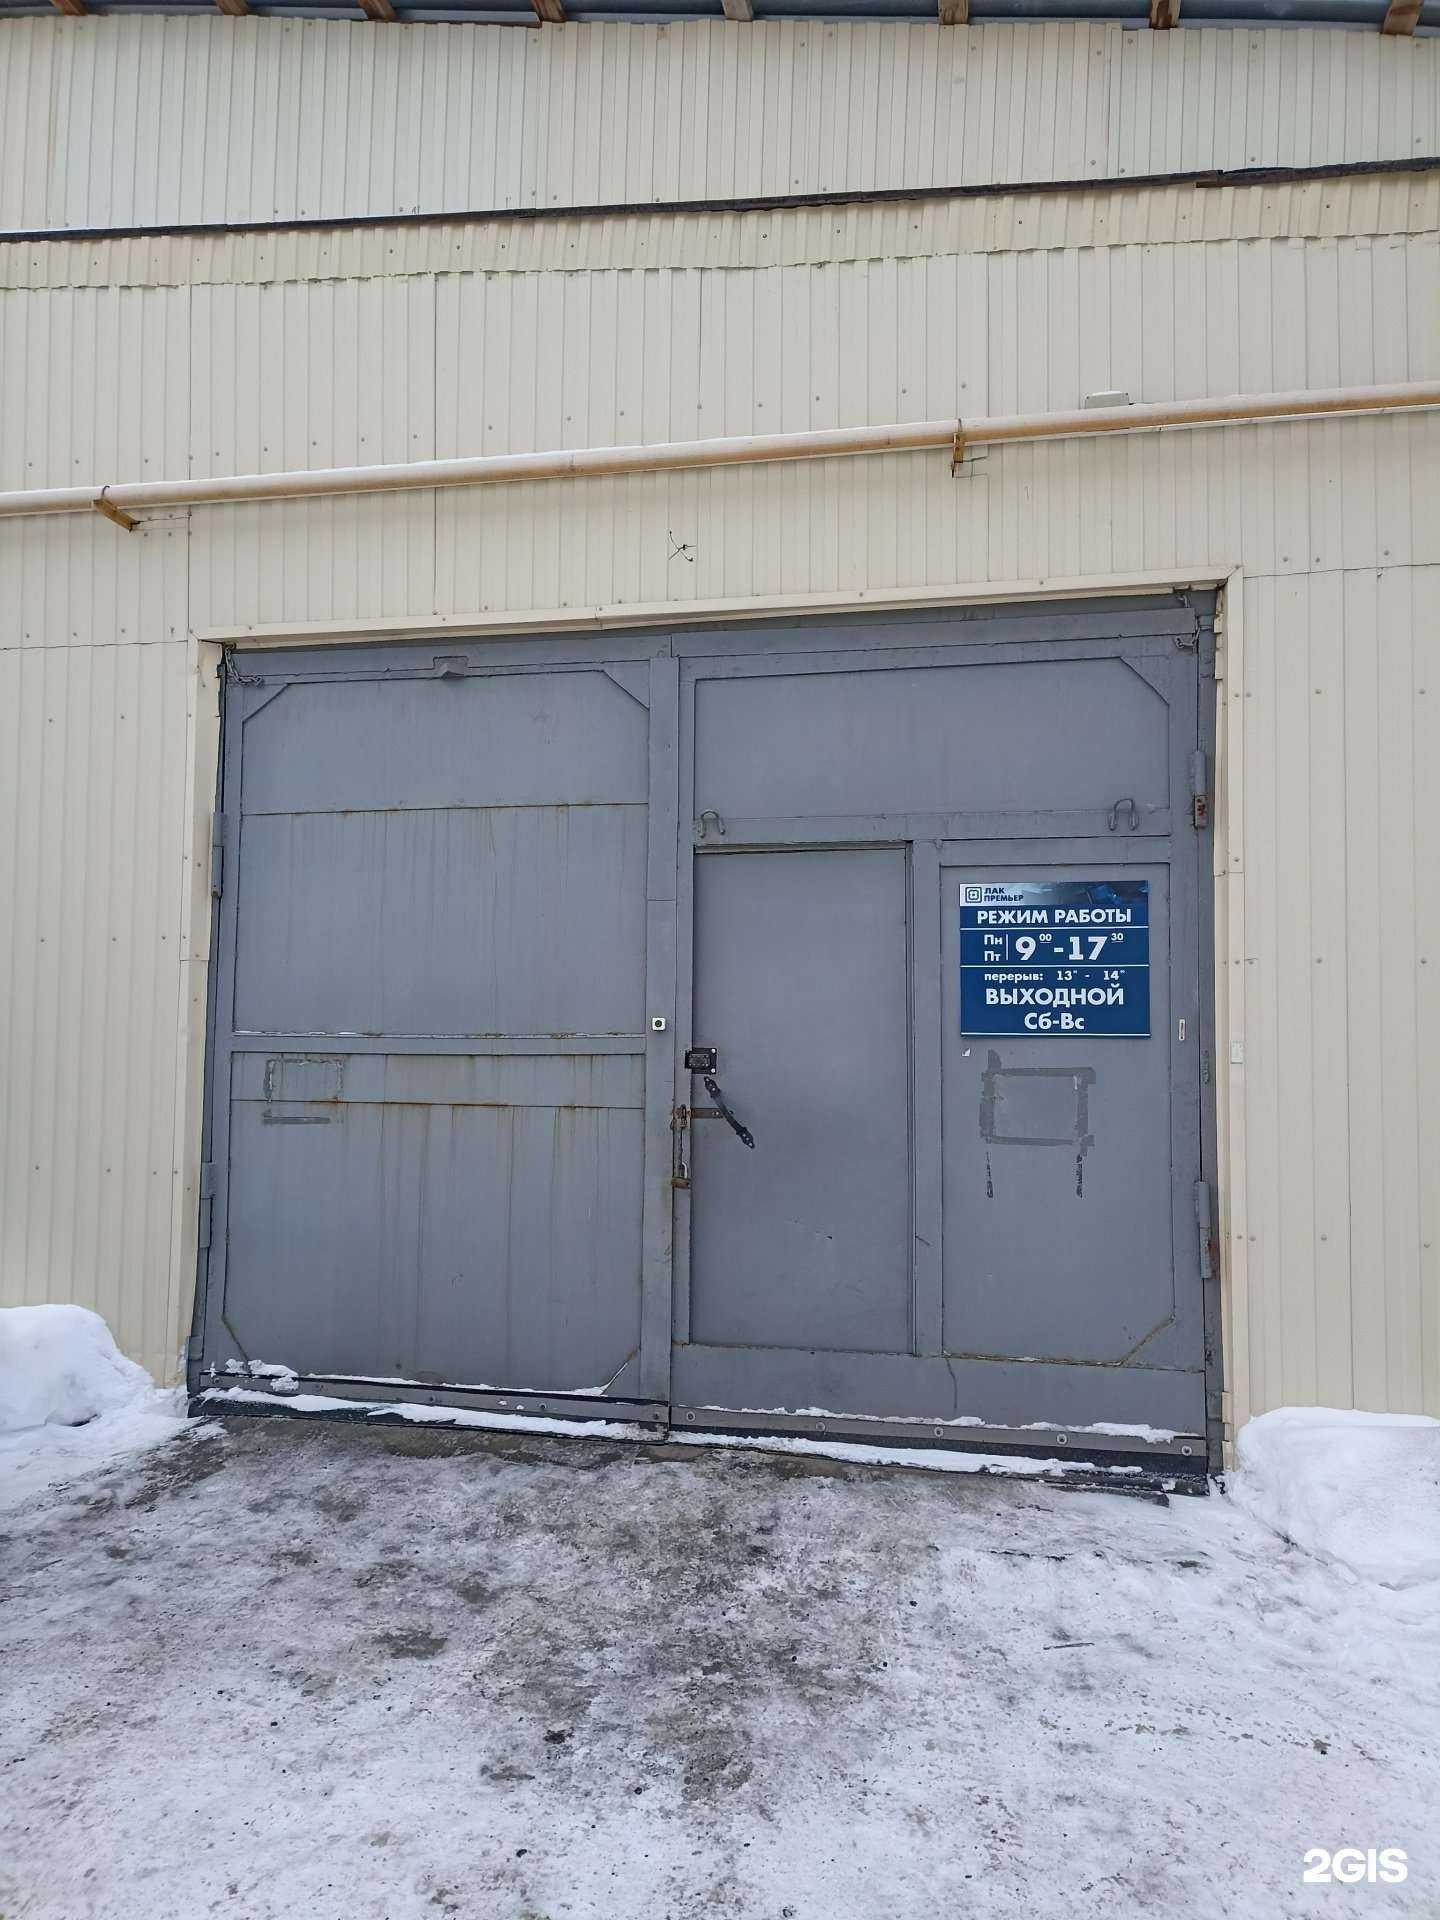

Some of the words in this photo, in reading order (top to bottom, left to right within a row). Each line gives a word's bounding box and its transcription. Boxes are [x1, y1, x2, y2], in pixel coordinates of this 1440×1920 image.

[984, 894, 1024, 902] ПРЕМЬЕР
[977, 910, 1049, 924] РЕЖИМ
[1054, 908, 1131, 924] РАБОТЫ
[984, 934, 1003, 945] Пн
[984, 950, 1001, 962] Пт
[984, 971, 1044, 983] перерыв:
[985, 983, 1124, 1008] ВЫХОДНОЙ
[1024, 1012, 1085, 1030] Сб-Вс
